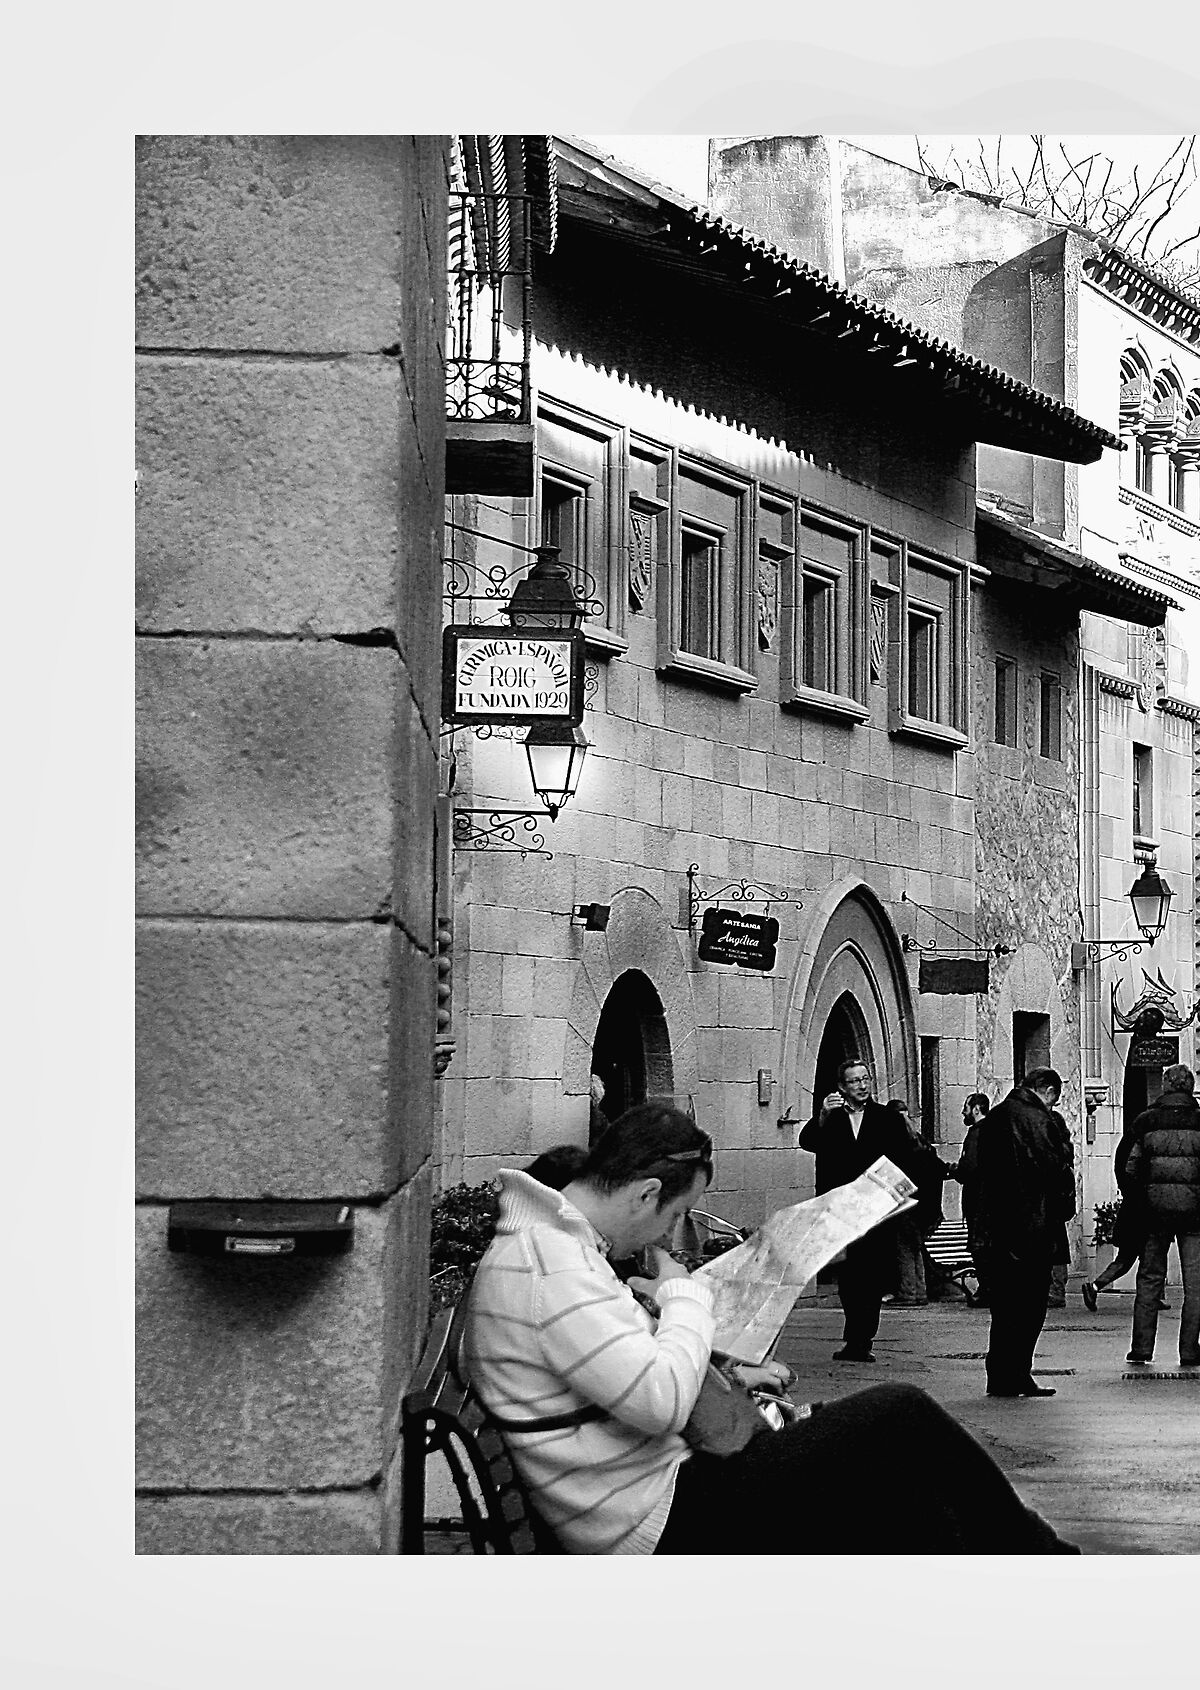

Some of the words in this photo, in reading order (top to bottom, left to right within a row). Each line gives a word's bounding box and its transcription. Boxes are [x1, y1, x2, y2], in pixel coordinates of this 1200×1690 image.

[489, 665, 536, 688] ROIG
[458, 692, 530, 708] FUNDADA
[535, 691, 568, 709] 1929
[723, 919, 761, 930] ARTESANIA
